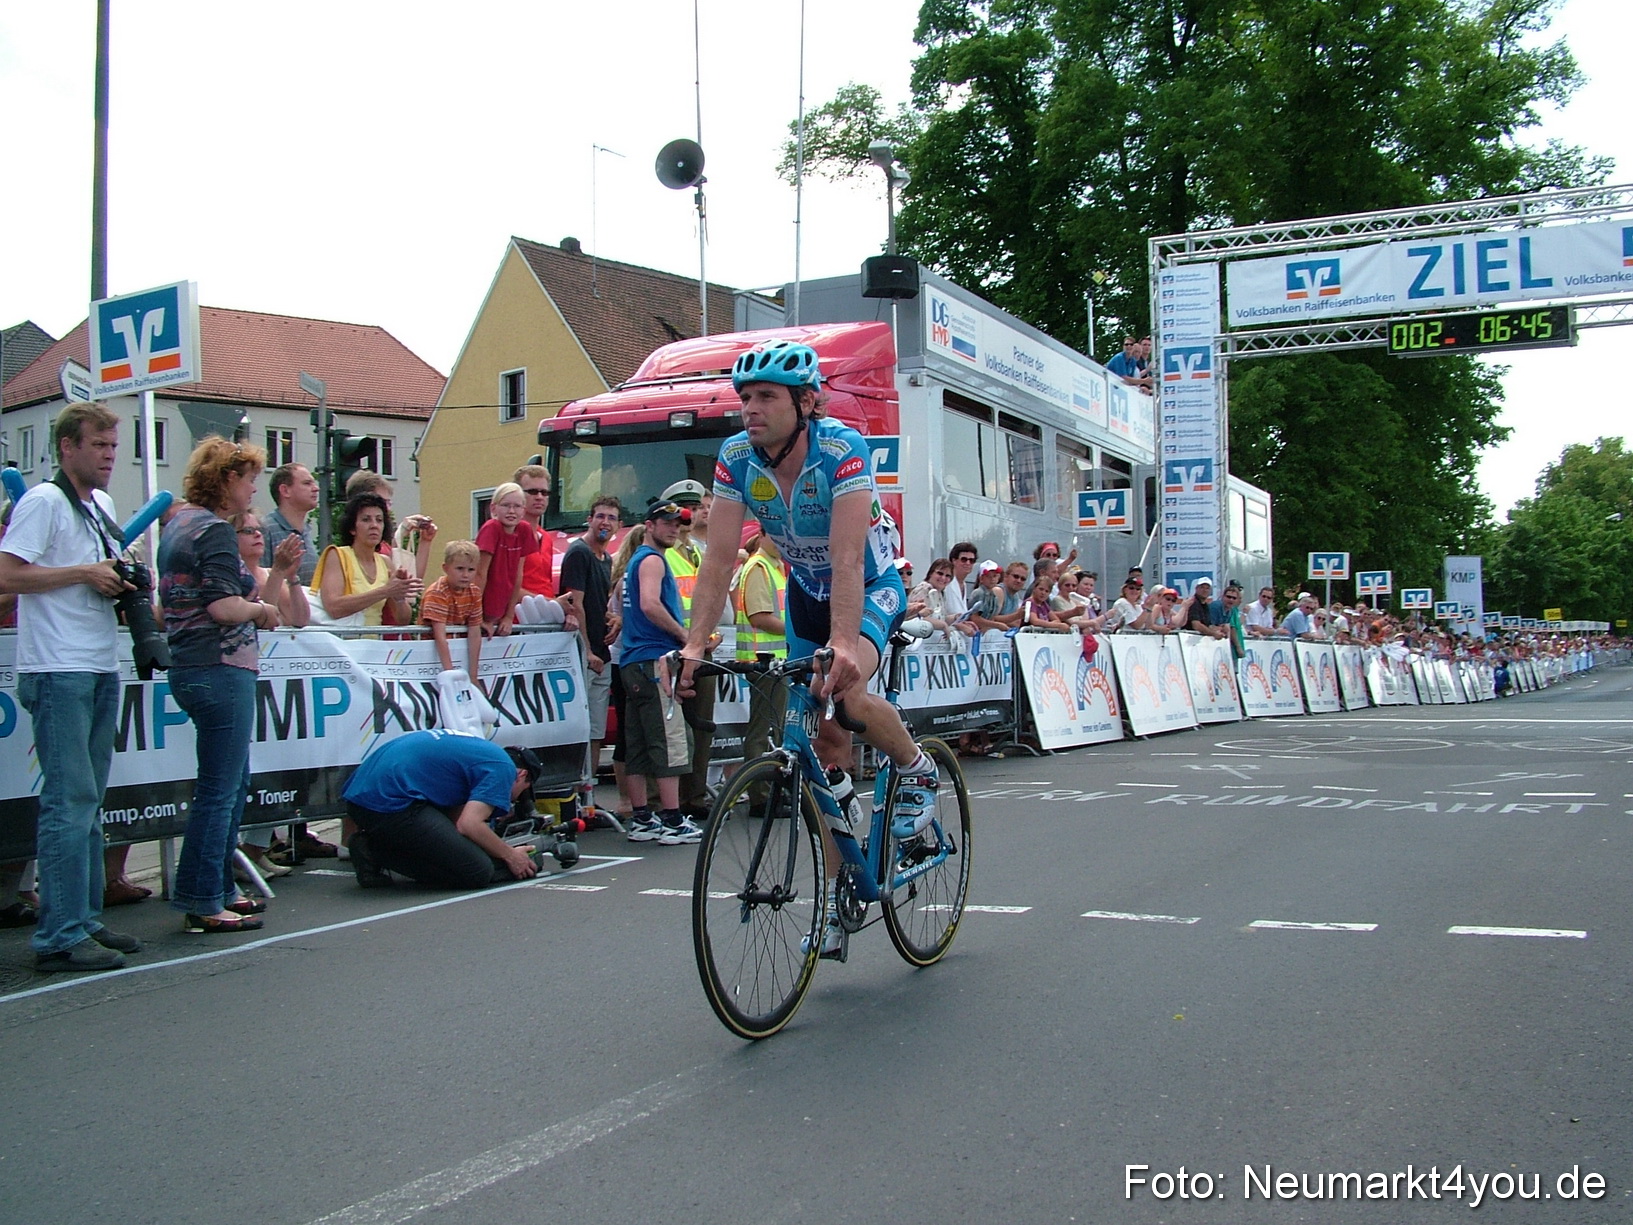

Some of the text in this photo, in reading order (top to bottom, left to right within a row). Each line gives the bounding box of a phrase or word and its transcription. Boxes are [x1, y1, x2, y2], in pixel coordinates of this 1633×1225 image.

[1407, 236, 1553, 299] ZIEL
[1564, 271, 1633, 287] Volksbanke
[932, 298, 949, 328] DG
[1236, 292, 1396, 318] Volksbanken Raiffeisenbanken
[1479, 311, 1551, 343] 06:45
[1013, 346, 1045, 372] Partner der
[94, 381, 133, 395] Volksbanken
[134, 371, 190, 386] Raiffeisenbanken
[985, 352, 1024, 382] Volksbanken
[1024, 372, 1069, 402] Raiffeisenbanken
[1450, 572, 1476, 584] KMP
[289, 660, 352, 671] PRODUCTS
[503, 661, 525, 670] TECH
[535, 657, 572, 666] PRODUCTS
[925, 653, 970, 690] KMP
[973, 652, 1011, 687] KMP
[249, 676, 352, 743] MP
[371, 676, 445, 735] KM
[479, 670, 577, 729] KMP
[113, 683, 190, 753] MP
[257, 789, 298, 806] Toner
[1143, 793, 1611, 815] RUNDFAHRT
[101, 802, 176, 825] kmp.com
